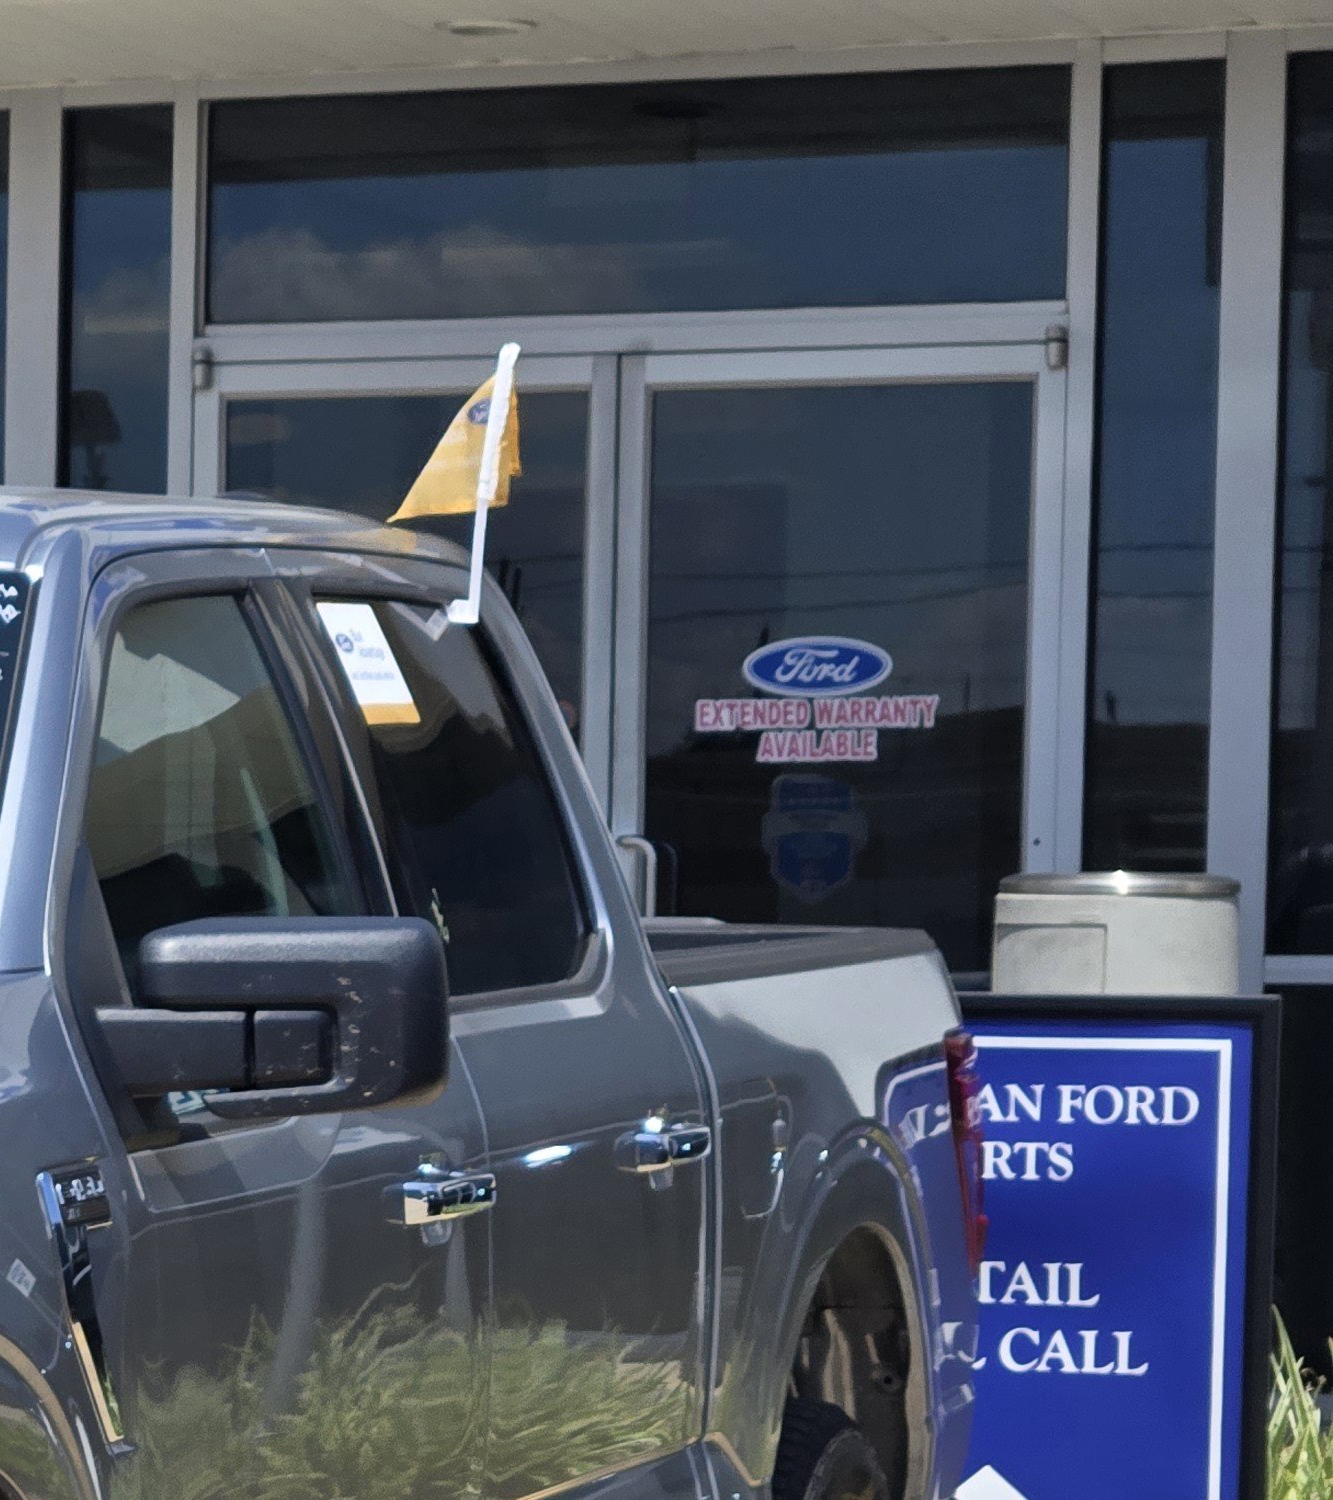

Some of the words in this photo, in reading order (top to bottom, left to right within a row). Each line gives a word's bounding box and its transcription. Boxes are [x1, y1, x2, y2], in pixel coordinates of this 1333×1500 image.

[775, 648, 861, 683] Ford
[696, 699, 810, 730] EXTENDED
[813, 696, 939, 729] WARRANTY
[757, 730, 877, 761] AVAILABLE
[1057, 1084, 1200, 1126] FORD
[981, 1140, 1074, 1182] RTS
[978, 1260, 1101, 1308] TAIL
[998, 1326, 1150, 1376] CALL
